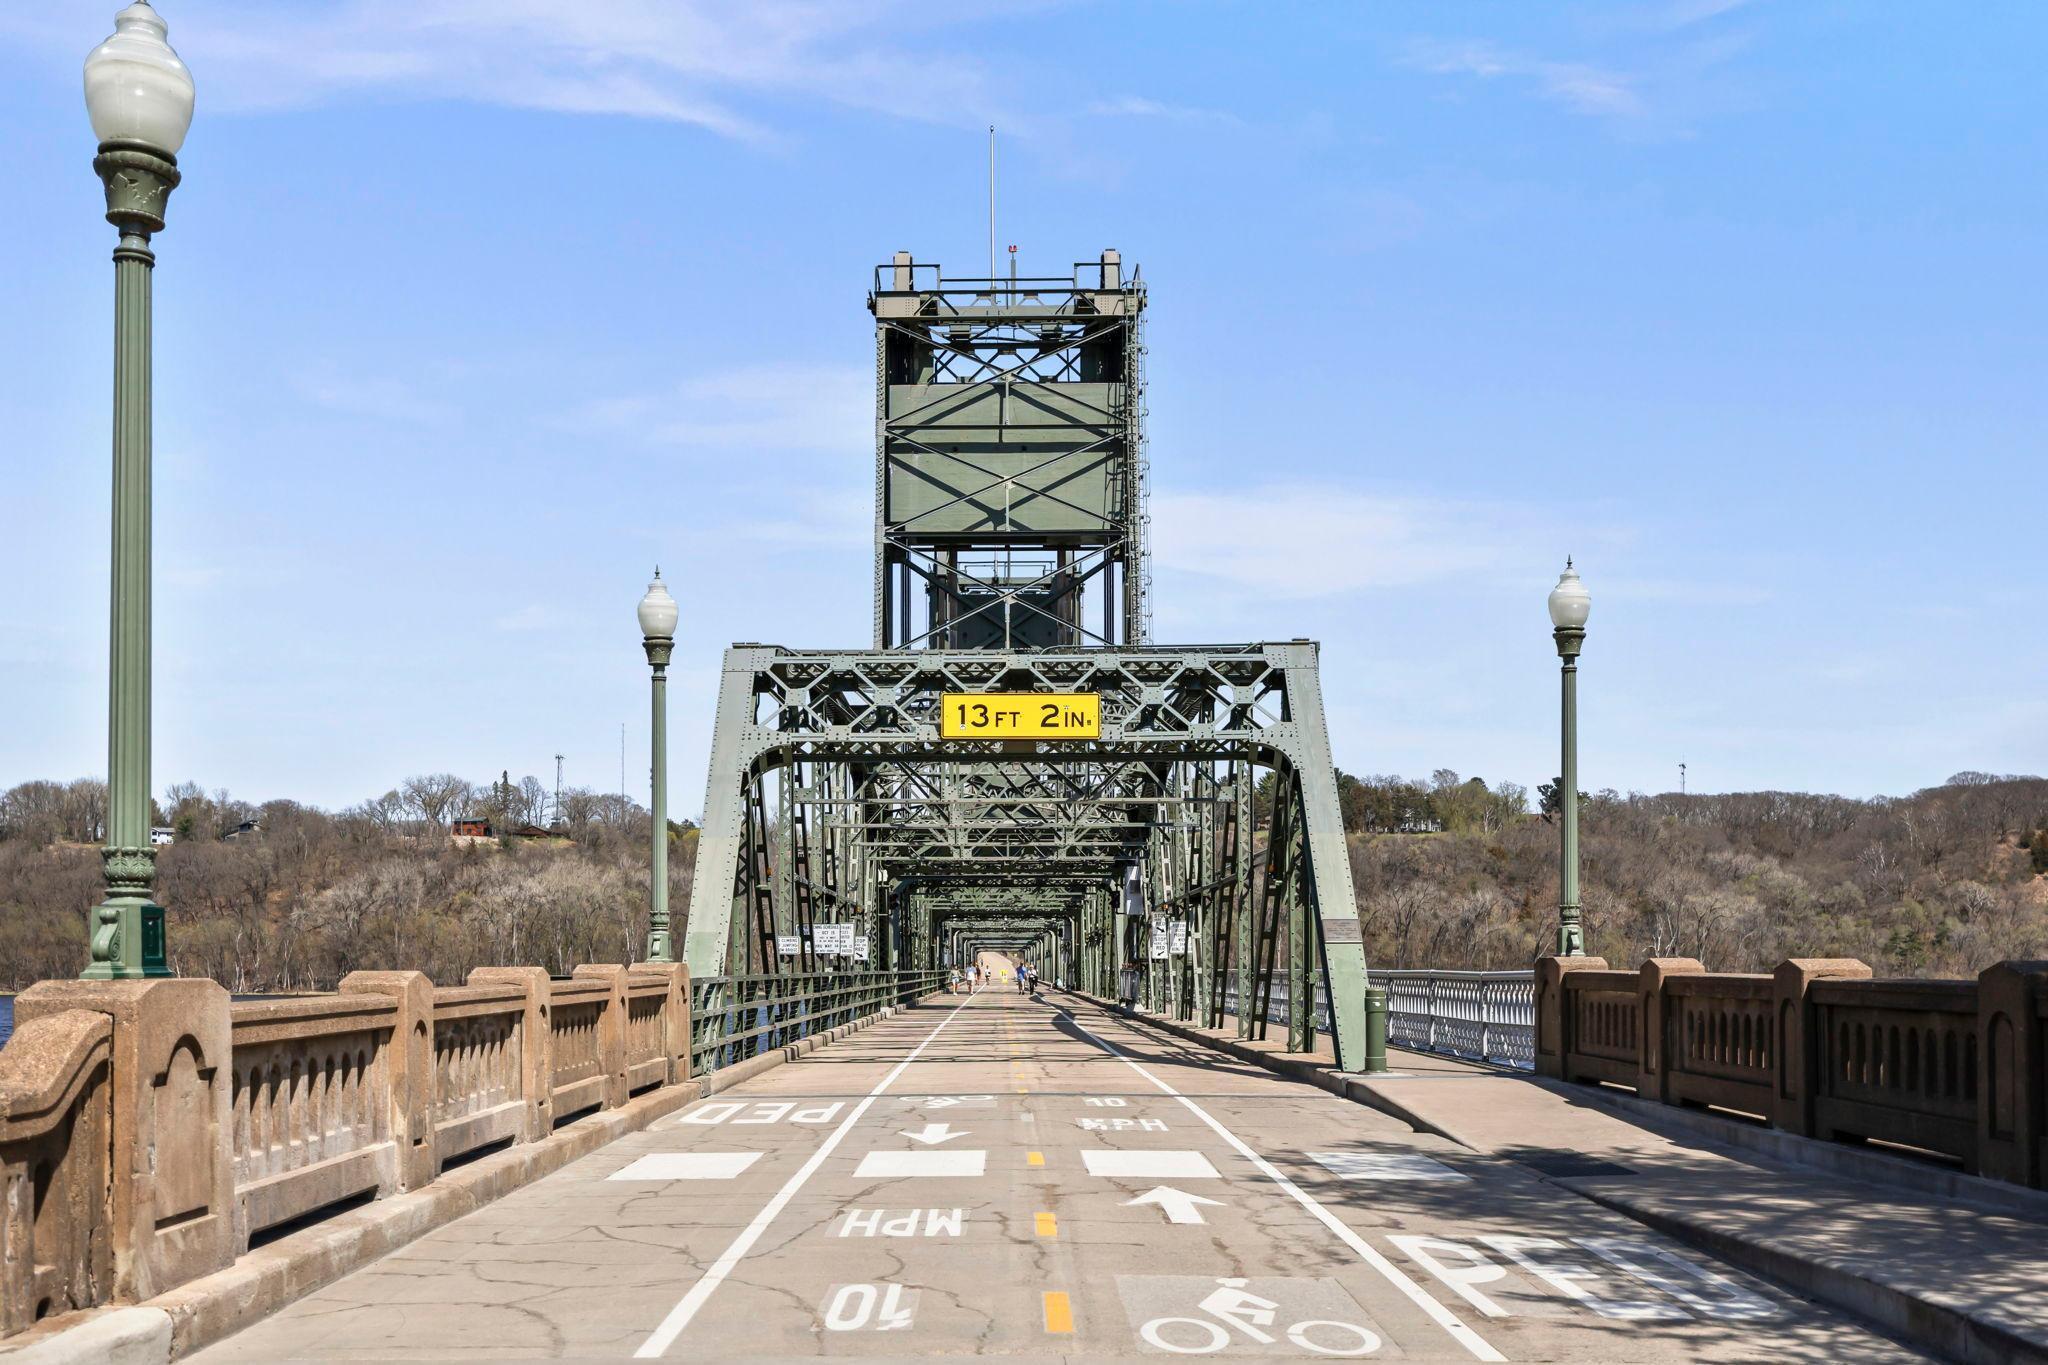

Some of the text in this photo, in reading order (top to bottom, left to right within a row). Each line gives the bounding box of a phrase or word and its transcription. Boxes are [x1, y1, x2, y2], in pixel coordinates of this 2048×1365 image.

[679, 1102, 845, 1124] PED
[1086, 1097, 1127, 1107] 10
[1081, 1119, 1169, 1132] MPH
[838, 1208, 963, 1237] MPH
[1385, 1235, 1780, 1320] PED
[824, 1283, 913, 1331] 10
